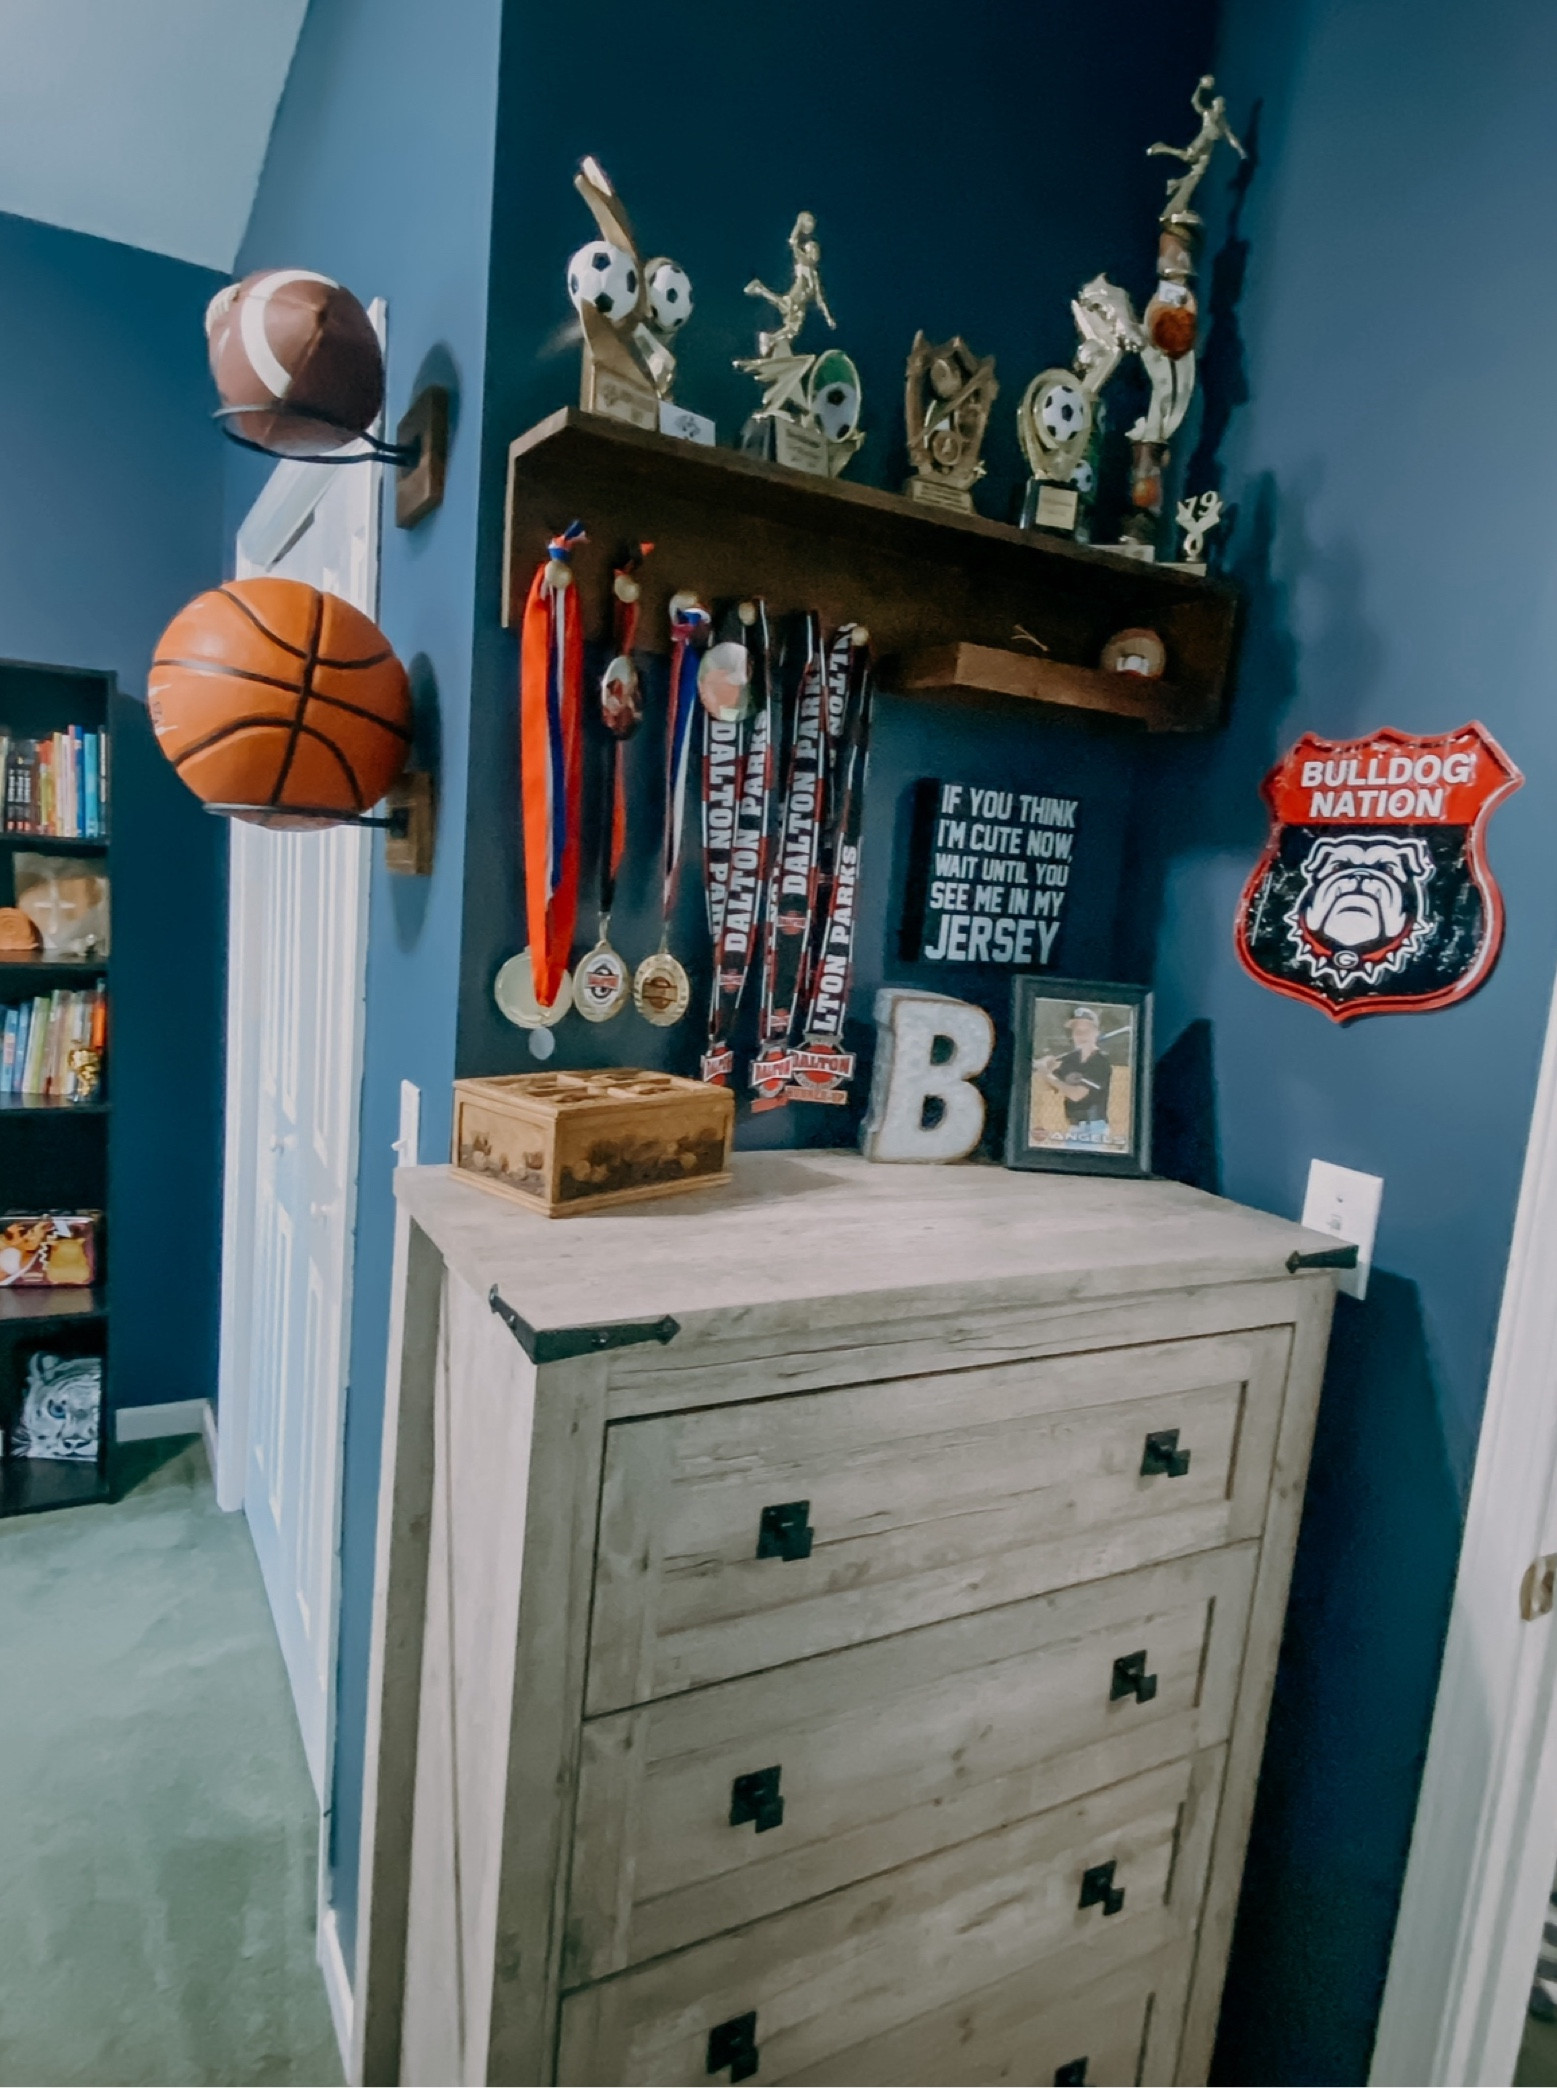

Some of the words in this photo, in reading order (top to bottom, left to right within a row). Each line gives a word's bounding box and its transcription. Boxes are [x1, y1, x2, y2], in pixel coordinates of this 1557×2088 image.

[708, 720, 737, 850] DALTON
[1301, 753, 1472, 787] BULLDOG
[941, 784, 963, 814] IF
[969, 787, 1013, 820] YOU
[1019, 795, 1078, 828] THINK
[1309, 788, 1444, 818] NATION
[782, 772, 816, 896] DALTON
[937, 818, 966, 849] I'M
[970, 824, 1023, 854] CUTE
[1026, 829, 1074, 864] NOW,
[724, 829, 760, 953] DALTON
[935, 852, 978, 879] WAIT
[981, 857, 1029, 884] UNTIL
[1035, 863, 1070, 887] YOU
[829, 845, 858, 945] PARKS
[930, 881, 969, 911] SEE
[973, 884, 1005, 913] ME
[1008, 887, 1029, 915] IN
[1032, 890, 1065, 917] MY
[924, 914, 1061, 964] JERSEY
[813, 953, 848, 1032] LTON
[868, 989, 997, 1165] B
